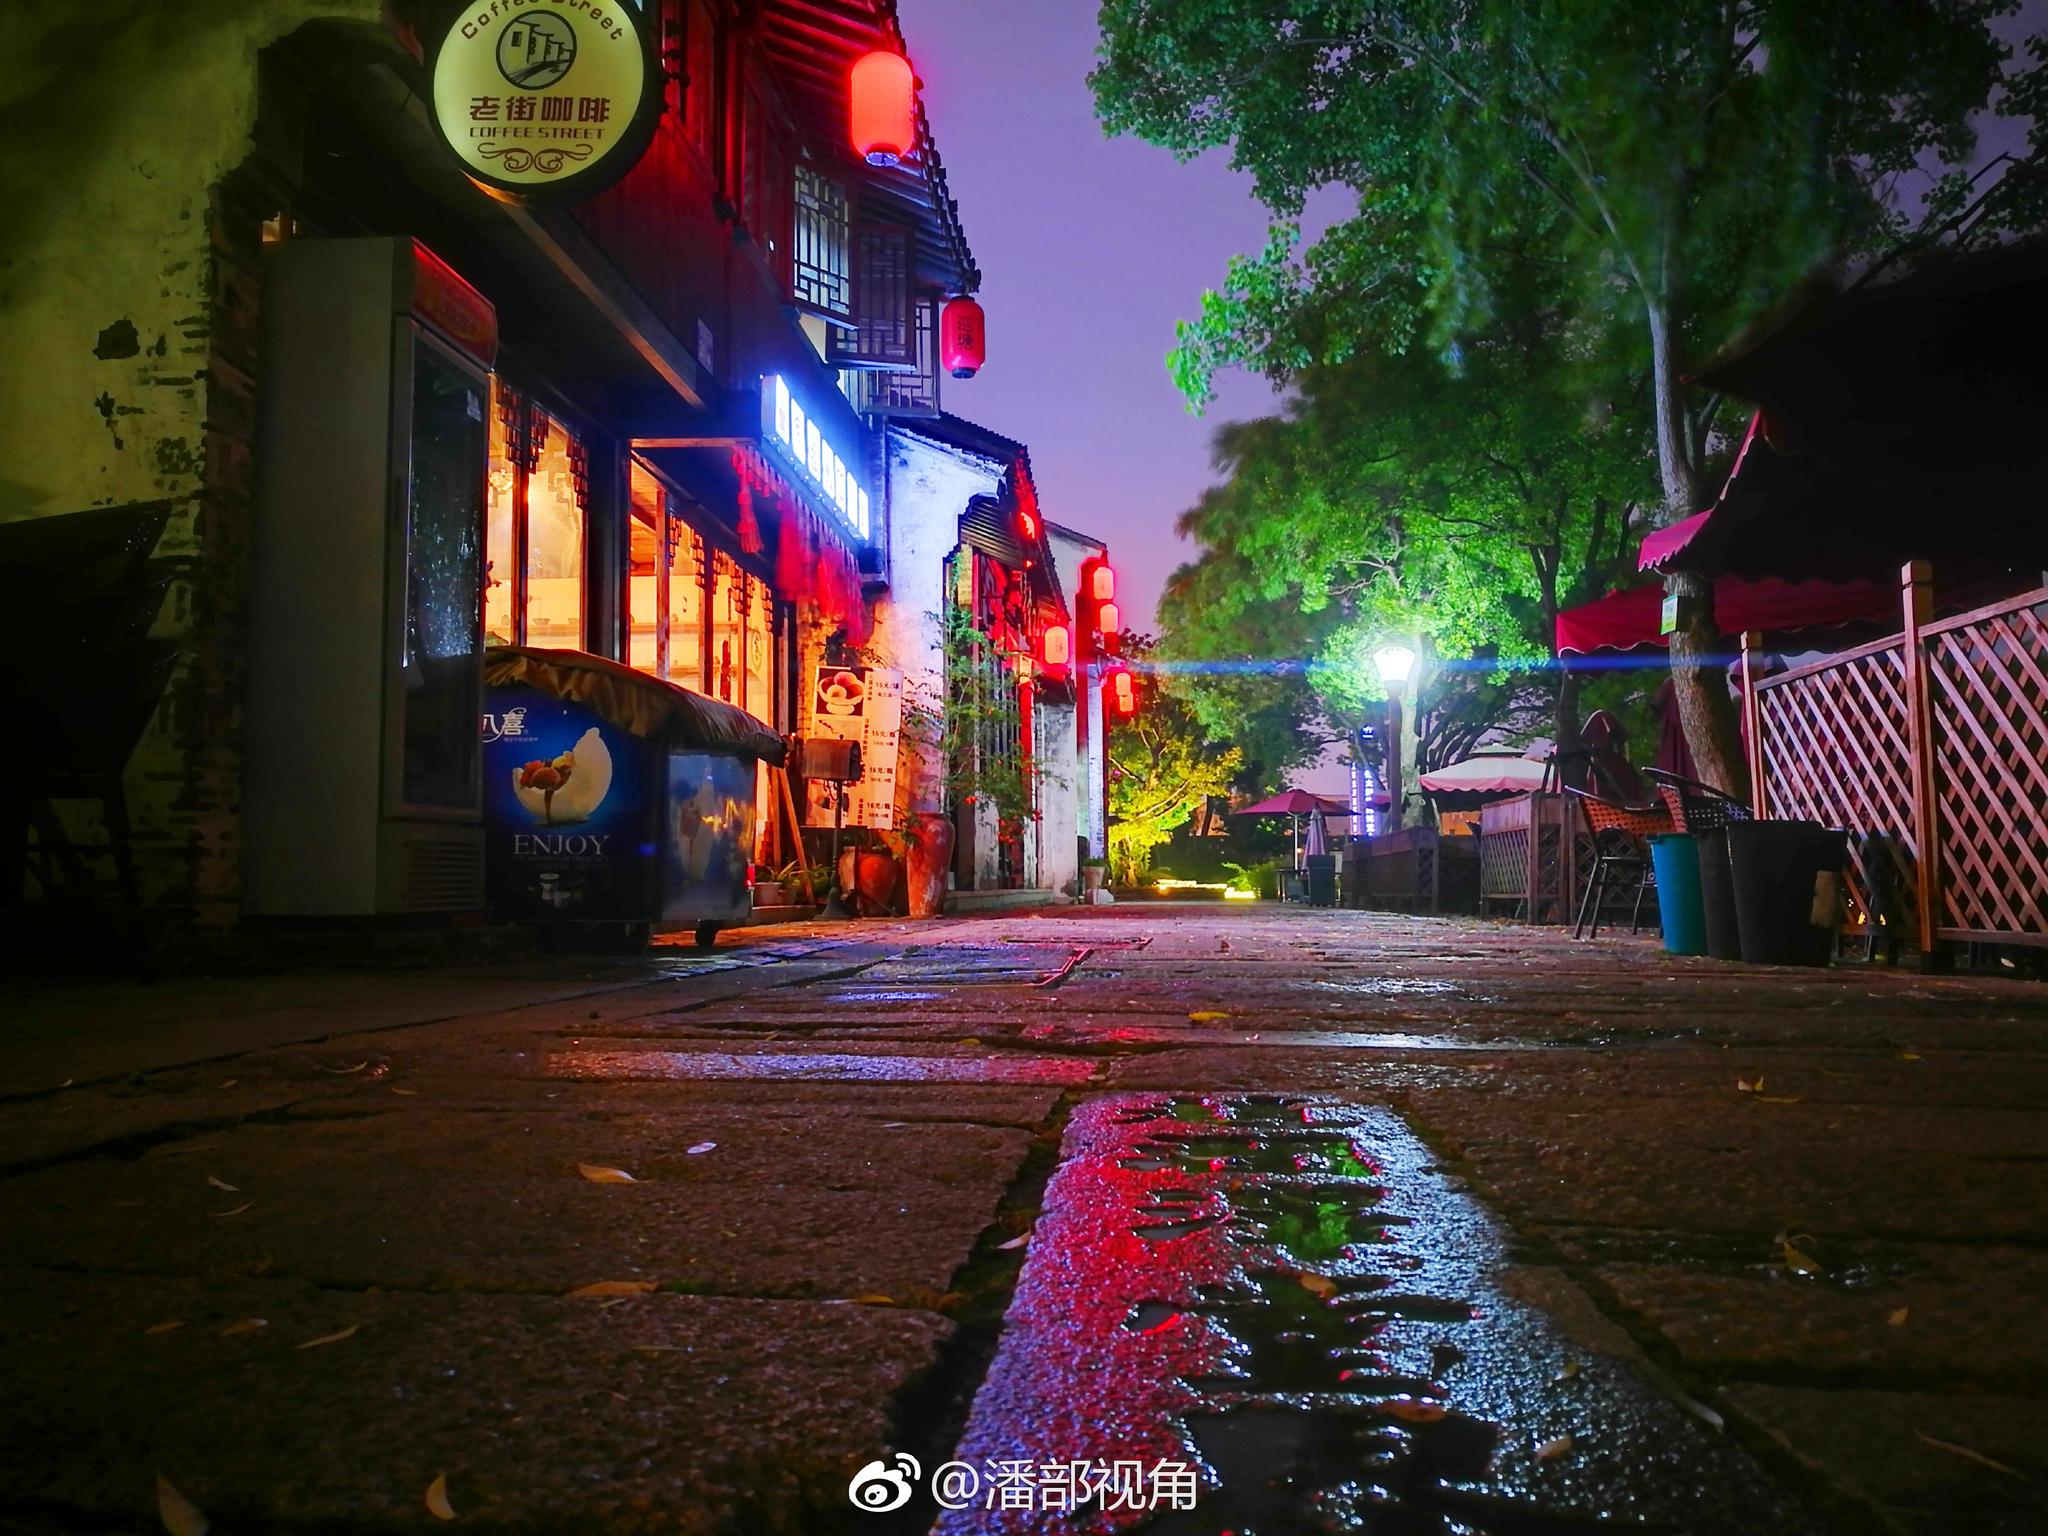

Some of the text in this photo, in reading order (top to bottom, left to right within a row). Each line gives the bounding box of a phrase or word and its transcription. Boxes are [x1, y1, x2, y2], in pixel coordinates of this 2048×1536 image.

[461, 0, 623, 40] Coffe treet
[470, 96, 610, 123] 老街咖啡
[470, 126, 605, 139] COFFEE STREET
[483, 707, 527, 736] 八喜
[513, 834, 611, 855] ENJOY
